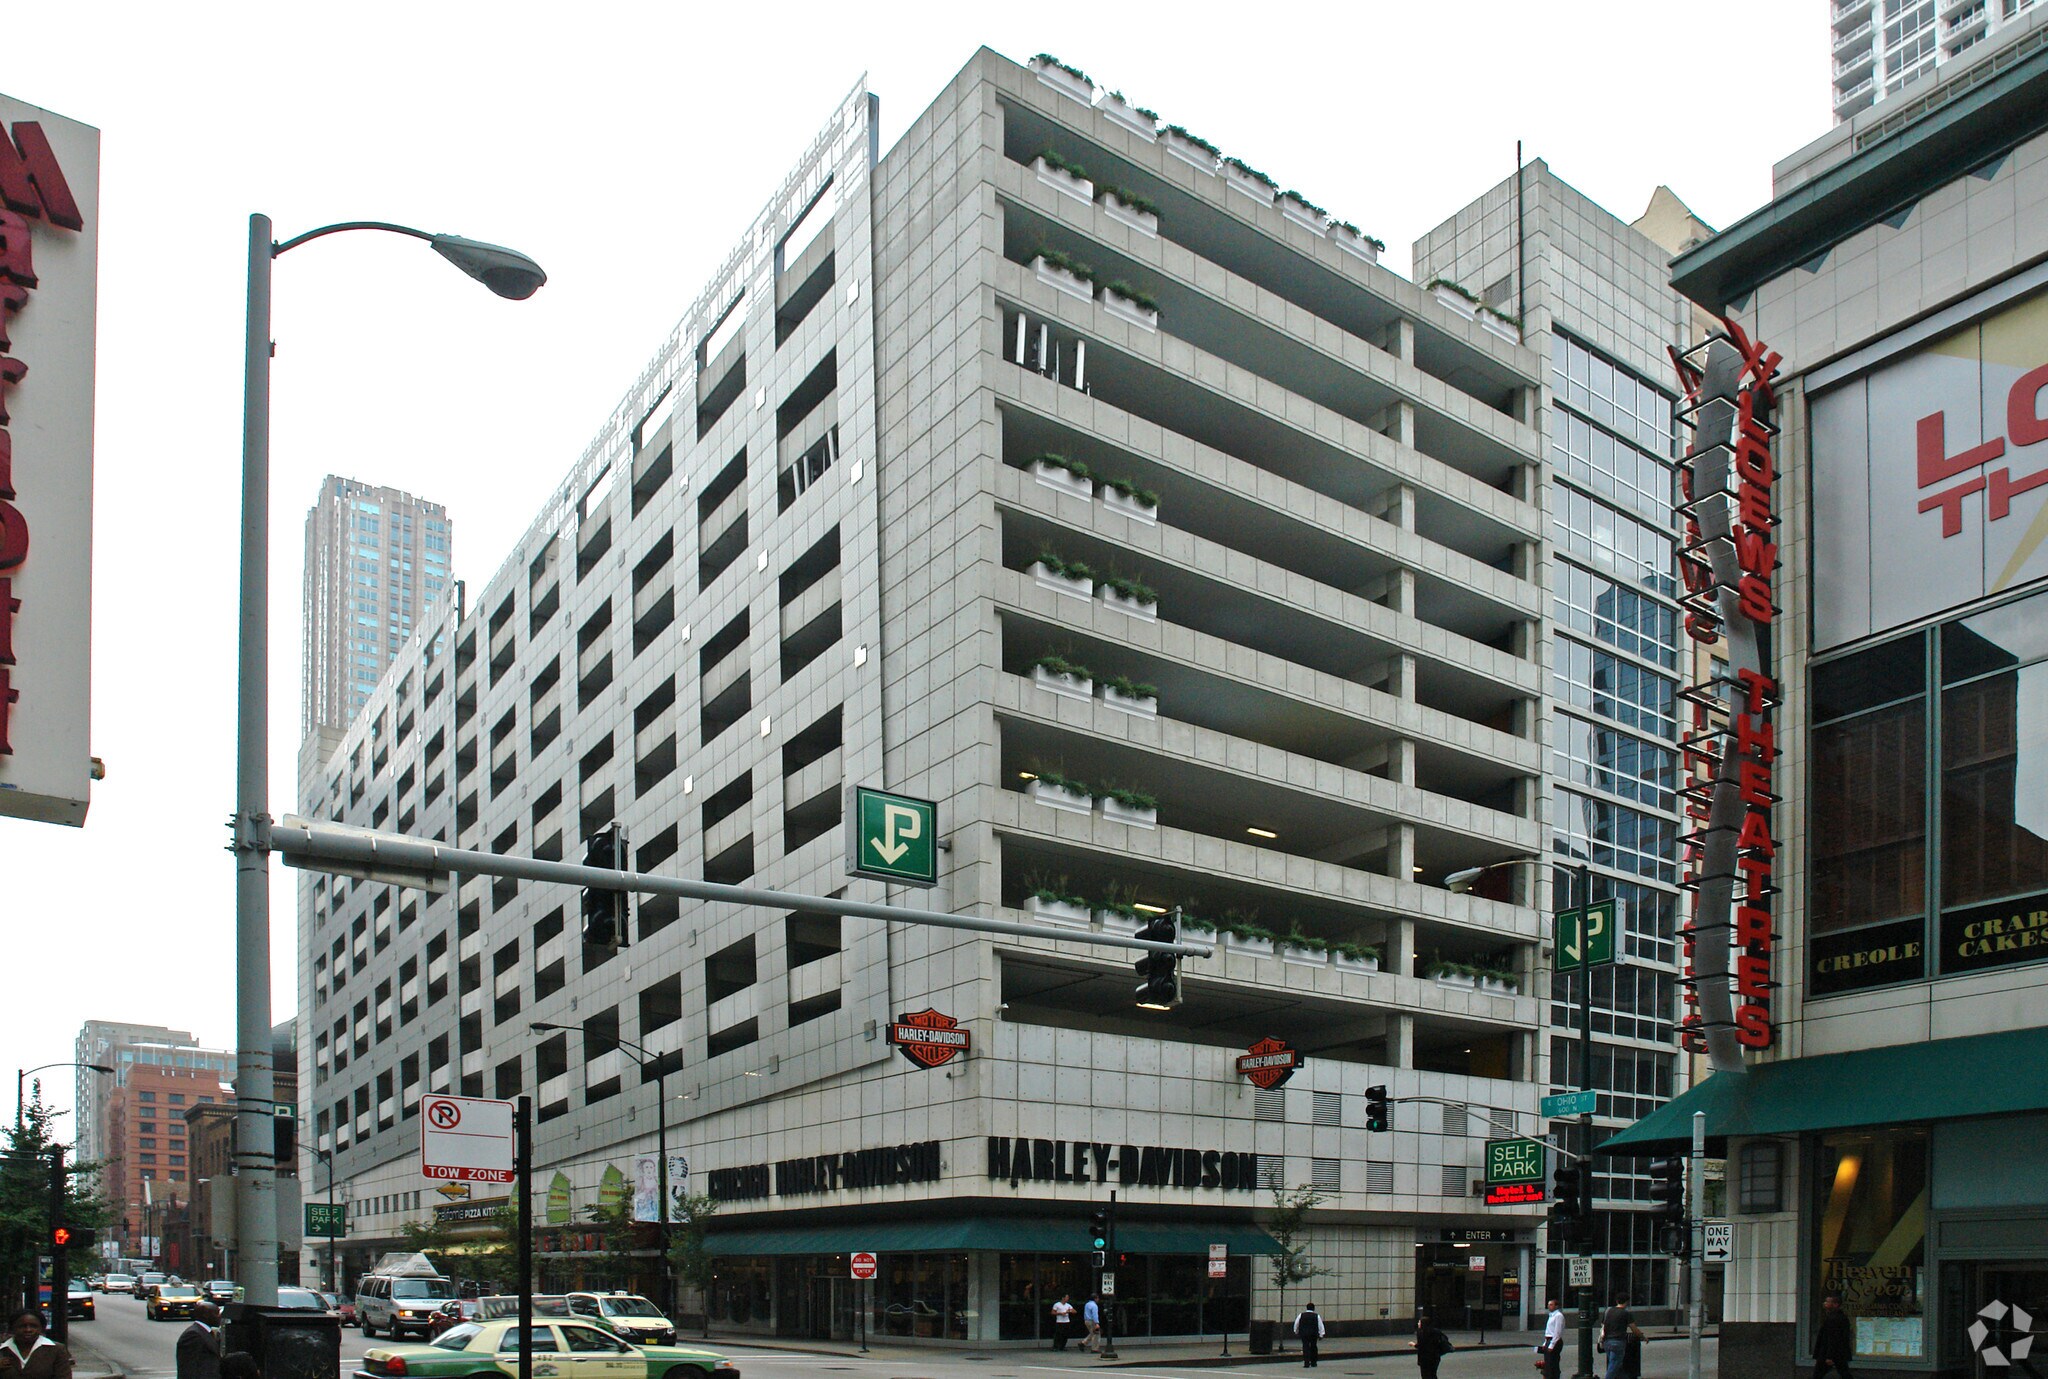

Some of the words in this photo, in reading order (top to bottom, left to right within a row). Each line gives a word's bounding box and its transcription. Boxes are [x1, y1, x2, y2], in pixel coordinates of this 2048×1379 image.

[1733, 390, 1777, 624] LOEWS
[1735, 668, 1776, 1050] THEATRES
[1964, 910, 2048, 939] CRAB
[1817, 942, 1920, 973] CREOLE
[913, 1012, 950, 1028] MOTOR
[898, 1027, 966, 1045] HARLEY-DAVIDSON
[915, 1046, 950, 1063] CYCLES
[1241, 1053, 1292, 1069] HARLEY-DAVIDSON
[1557, 1095, 1577, 1106] OHIO
[1494, 1144, 1536, 1162] SELF
[708, 1163, 770, 1200] CHICAGO
[776, 1140, 940, 1195] HARLEY-DAVIDSON
[987, 1136, 1258, 1190] HARLEY-DAVIDSON
[1493, 1160, 1536, 1177] PARK
[428, 1166, 460, 1178] TOW
[468, 1169, 507, 1181] ZONE
[1487, 1191, 1543, 1203] Restaurant
[311, 1207, 338, 1216] SELF
[464, 1208, 481, 1219] PIZZA
[311, 1216, 340, 1224] PARK
[1465, 1231, 1491, 1239] ENTER
[1707, 1227, 1729, 1236] ONE
[1707, 1237, 1730, 1246] WAY
[1831, 1261, 1912, 1280] Heaven
